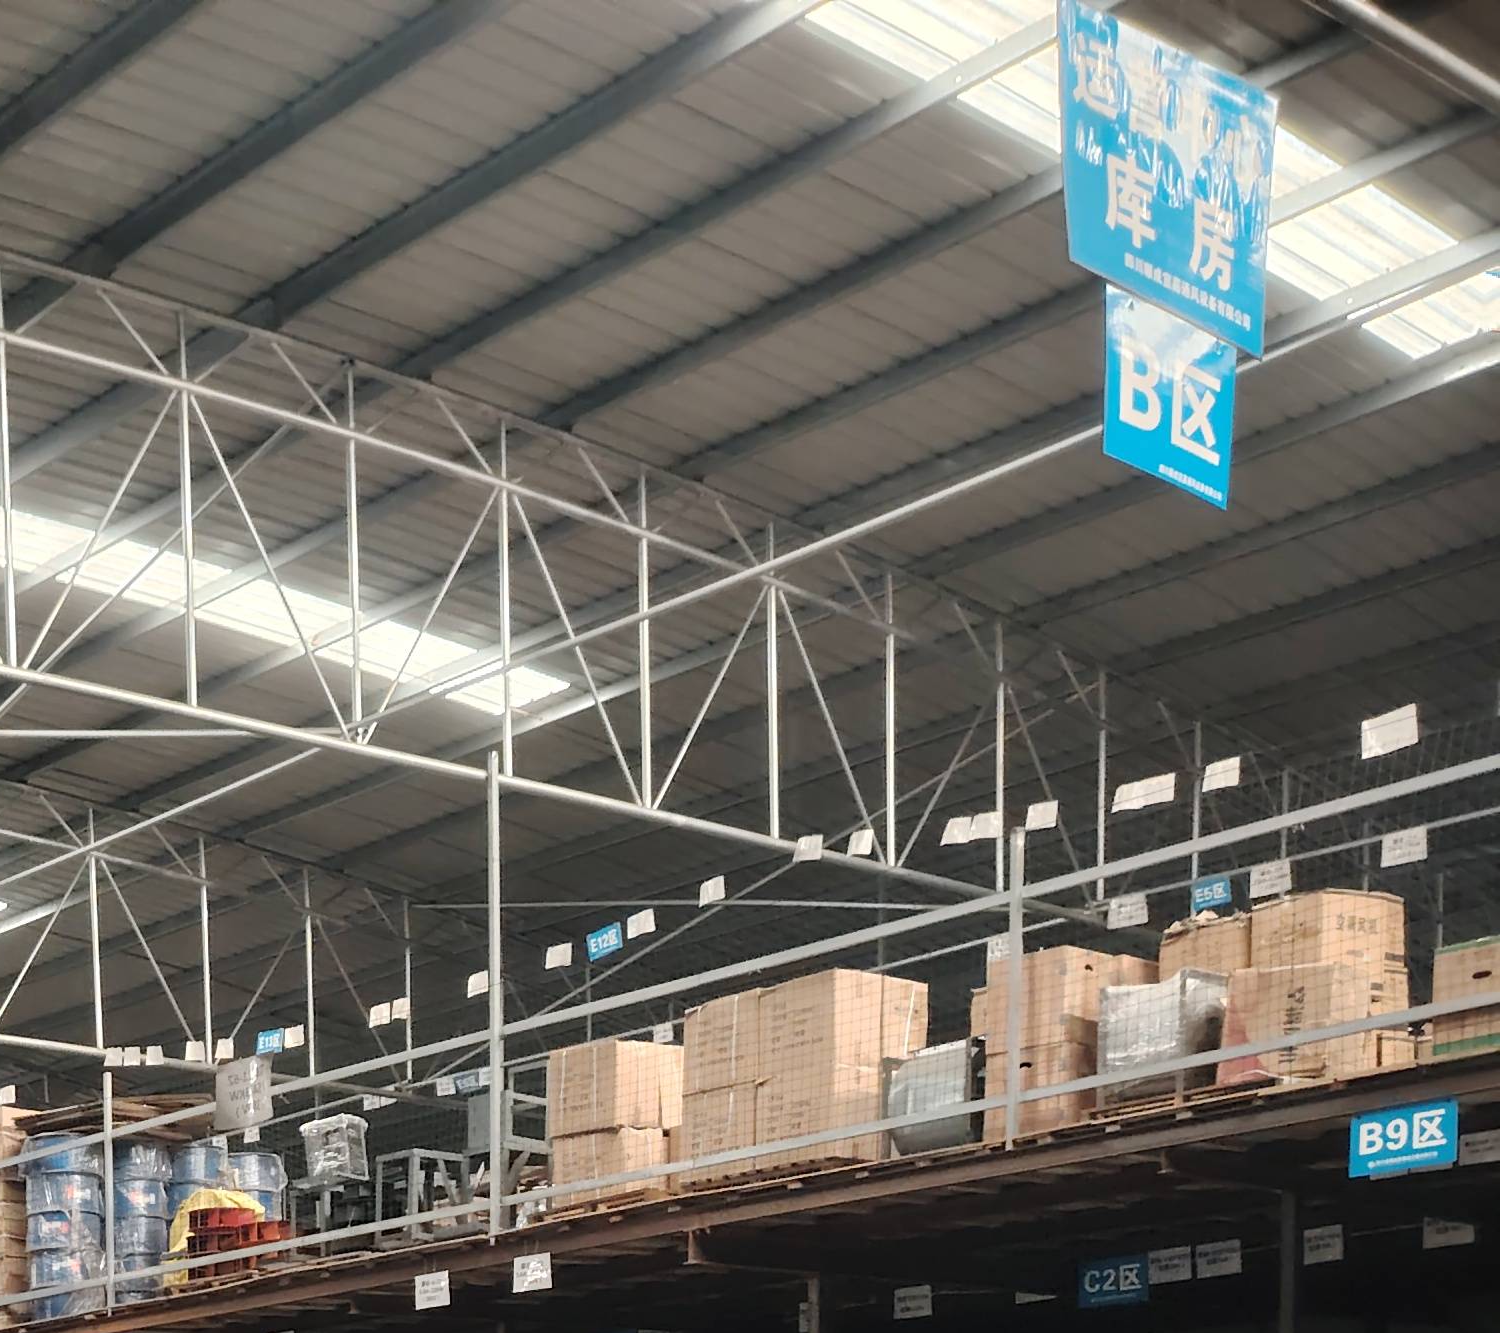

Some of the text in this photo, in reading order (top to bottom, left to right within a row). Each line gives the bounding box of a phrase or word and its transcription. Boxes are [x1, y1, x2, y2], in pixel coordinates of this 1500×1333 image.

[1105, 147, 1236, 292] 库房
[1118, 338, 1222, 467] B区
[1358, 1108, 1448, 1156] B9区
[1084, 1263, 1142, 1293] C2区
